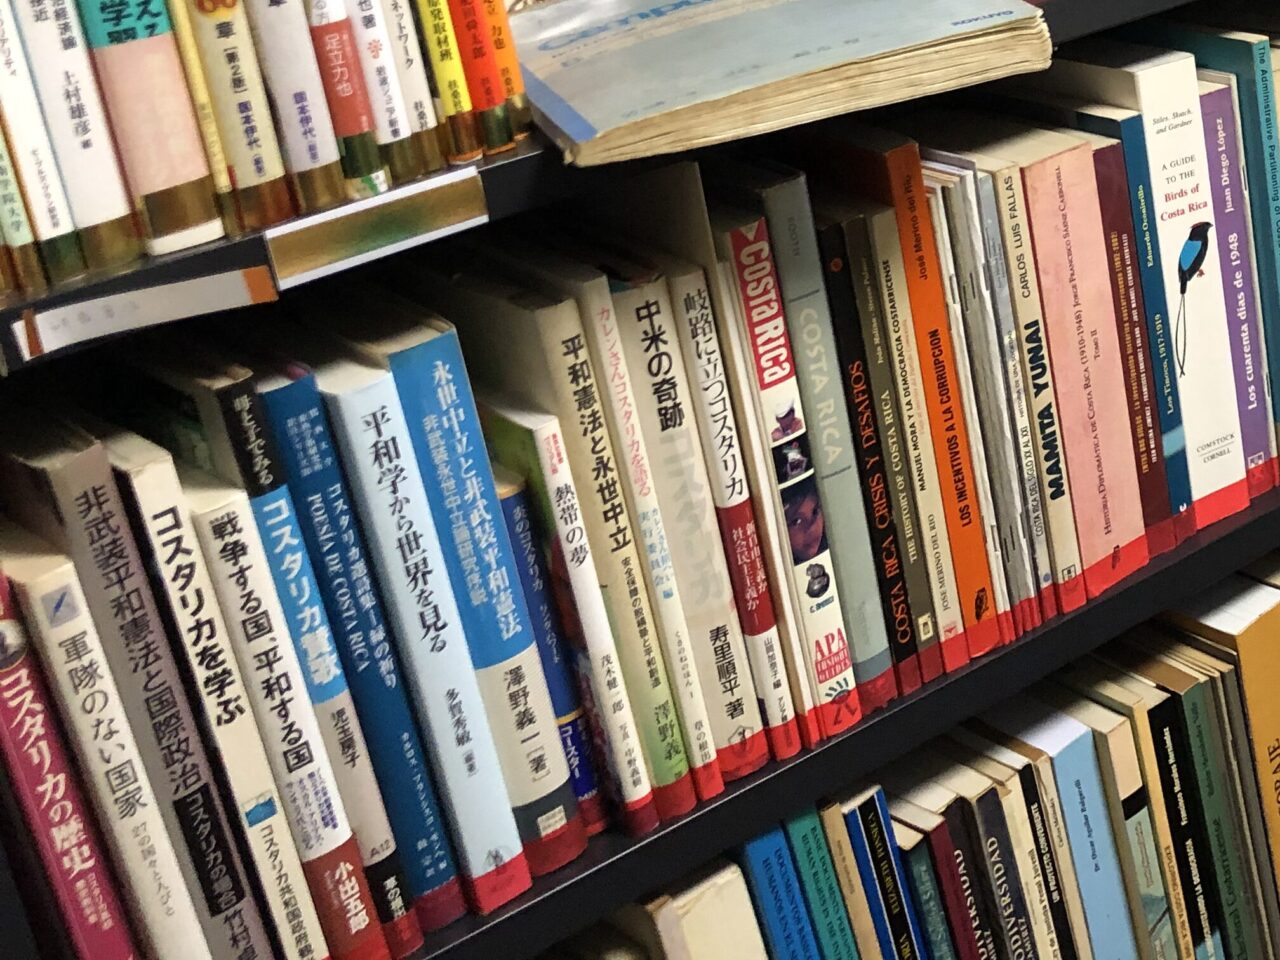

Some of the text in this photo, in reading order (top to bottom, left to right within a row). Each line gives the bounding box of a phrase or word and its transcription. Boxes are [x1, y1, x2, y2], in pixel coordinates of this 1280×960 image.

[62, 71, 93, 138] 上村雄彦
[323, 34, 353, 97] 足立力也
[1169, 118, 1193, 131] Gardner
[1164, 188, 1186, 204] Birds
[1170, 155, 1196, 168] GUIDE
[1179, 170, 1196, 181] THE
[1260, 66, 1280, 203] Administrative Partitioning
[1004, 175, 1031, 299] CARLOS LUIS FALLAS
[1160, 200, 1208, 221] Costa Rica
[636, 299, 685, 429] 中米の奇跡
[882, 259, 926, 491] MANUEL DEMOCRACIA COSTARRICENSE
[1230, 232, 1257, 385] cuarenta 1948
[561, 333, 633, 554] 平和憲法と永世中立
[683, 290, 745, 502] 岐路に立つコスタリカ
[800, 307, 842, 465] COSTA RICA
[928, 329, 970, 507] INCENTIVOS CORRUPCION
[1024, 319, 1067, 502] MAMITA YUNAI
[1196, 432, 1235, 454] COMSTOCK
[430, 360, 523, 640] 永世中立と非武装平和憲法
[848, 360, 912, 644] COSTA RICA CRISIS DESAFIOS
[880, 390, 914, 544] HISTORY COSTA RICA
[1203, 448, 1232, 465] CORNELL
[306, 493, 335, 554] POESÍA
[331, 577, 359, 631] COSTA
[348, 630, 370, 673] RICA
[361, 404, 448, 654] 平和学から世界を見る
[553, 484, 589, 568] 熱帯の夢
[75, 485, 203, 796] 非武装平和憲法と国際政治
[152, 505, 246, 727] コスタリカを学ぶ
[600, 654, 626, 715] 茂木健一郎
[814, 627, 848, 660] APA
[0, 668, 96, 880] コスタリカの歴史
[57, 631, 148, 819] 軍隊のない国家
[369, 839, 391, 858] A12
[867, 811, 899, 915] ELIZABETH FONSECA
